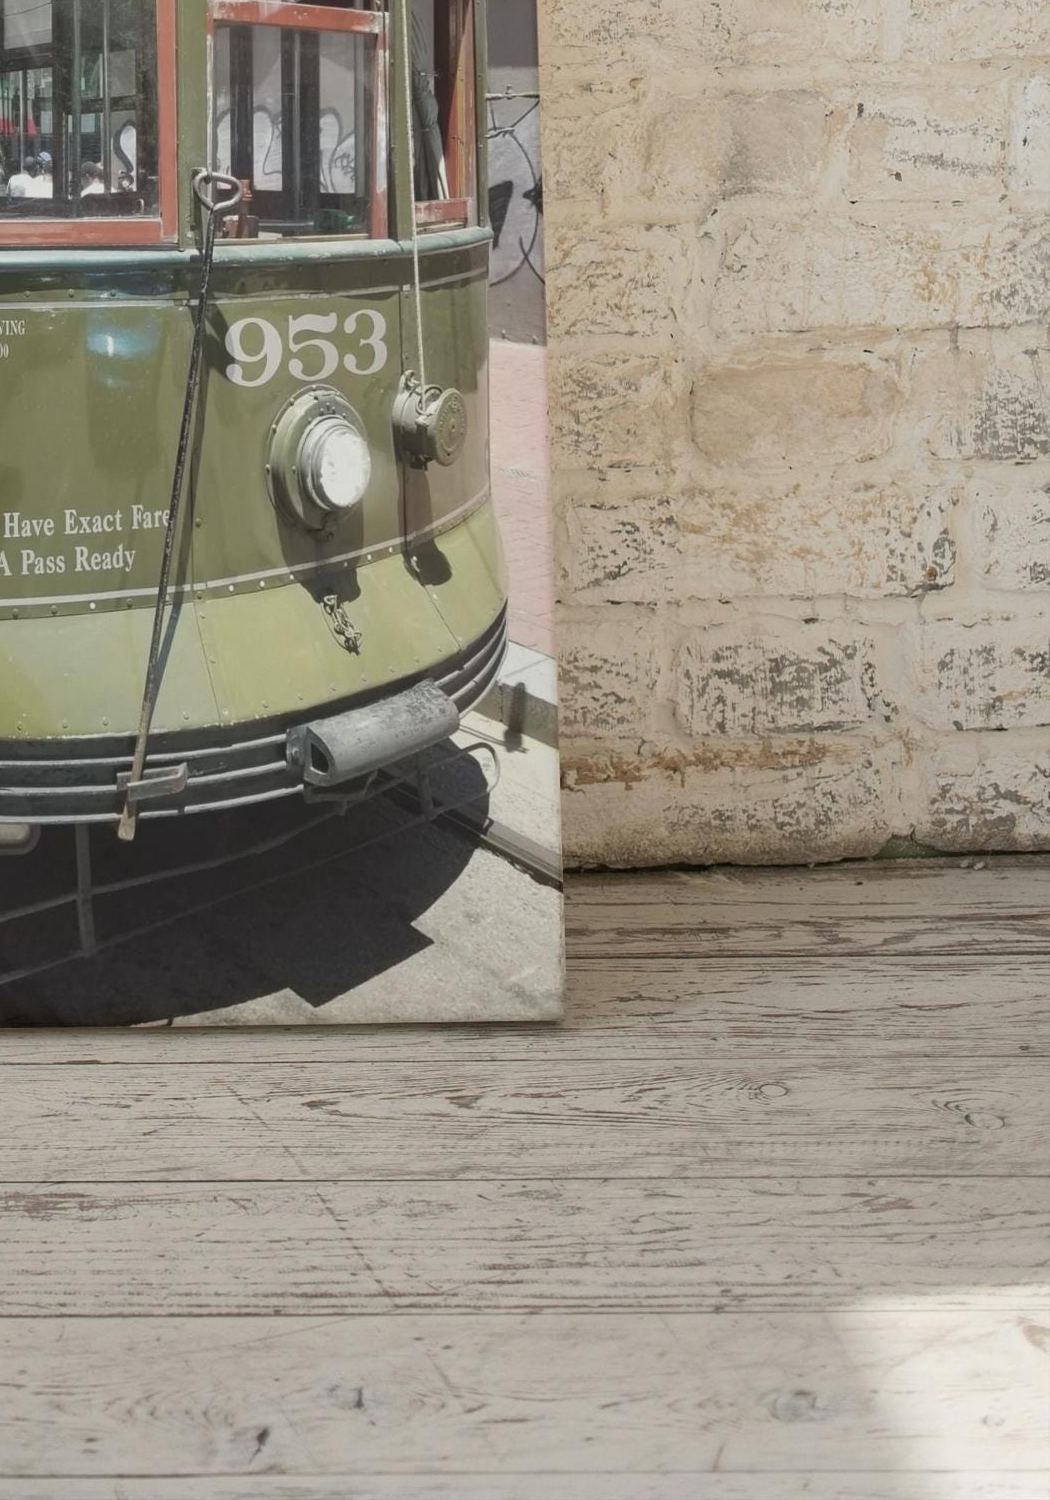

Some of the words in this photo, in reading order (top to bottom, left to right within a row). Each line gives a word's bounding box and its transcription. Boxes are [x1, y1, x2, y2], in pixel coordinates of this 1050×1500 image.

[224, 308, 389, 388] 953
[2, 511, 55, 538] Have
[63, 508, 123, 535] Exact
[130, 504, 171, 530] Fare
[21, 549, 66, 576] Pass
[74, 543, 137, 573] Ready
